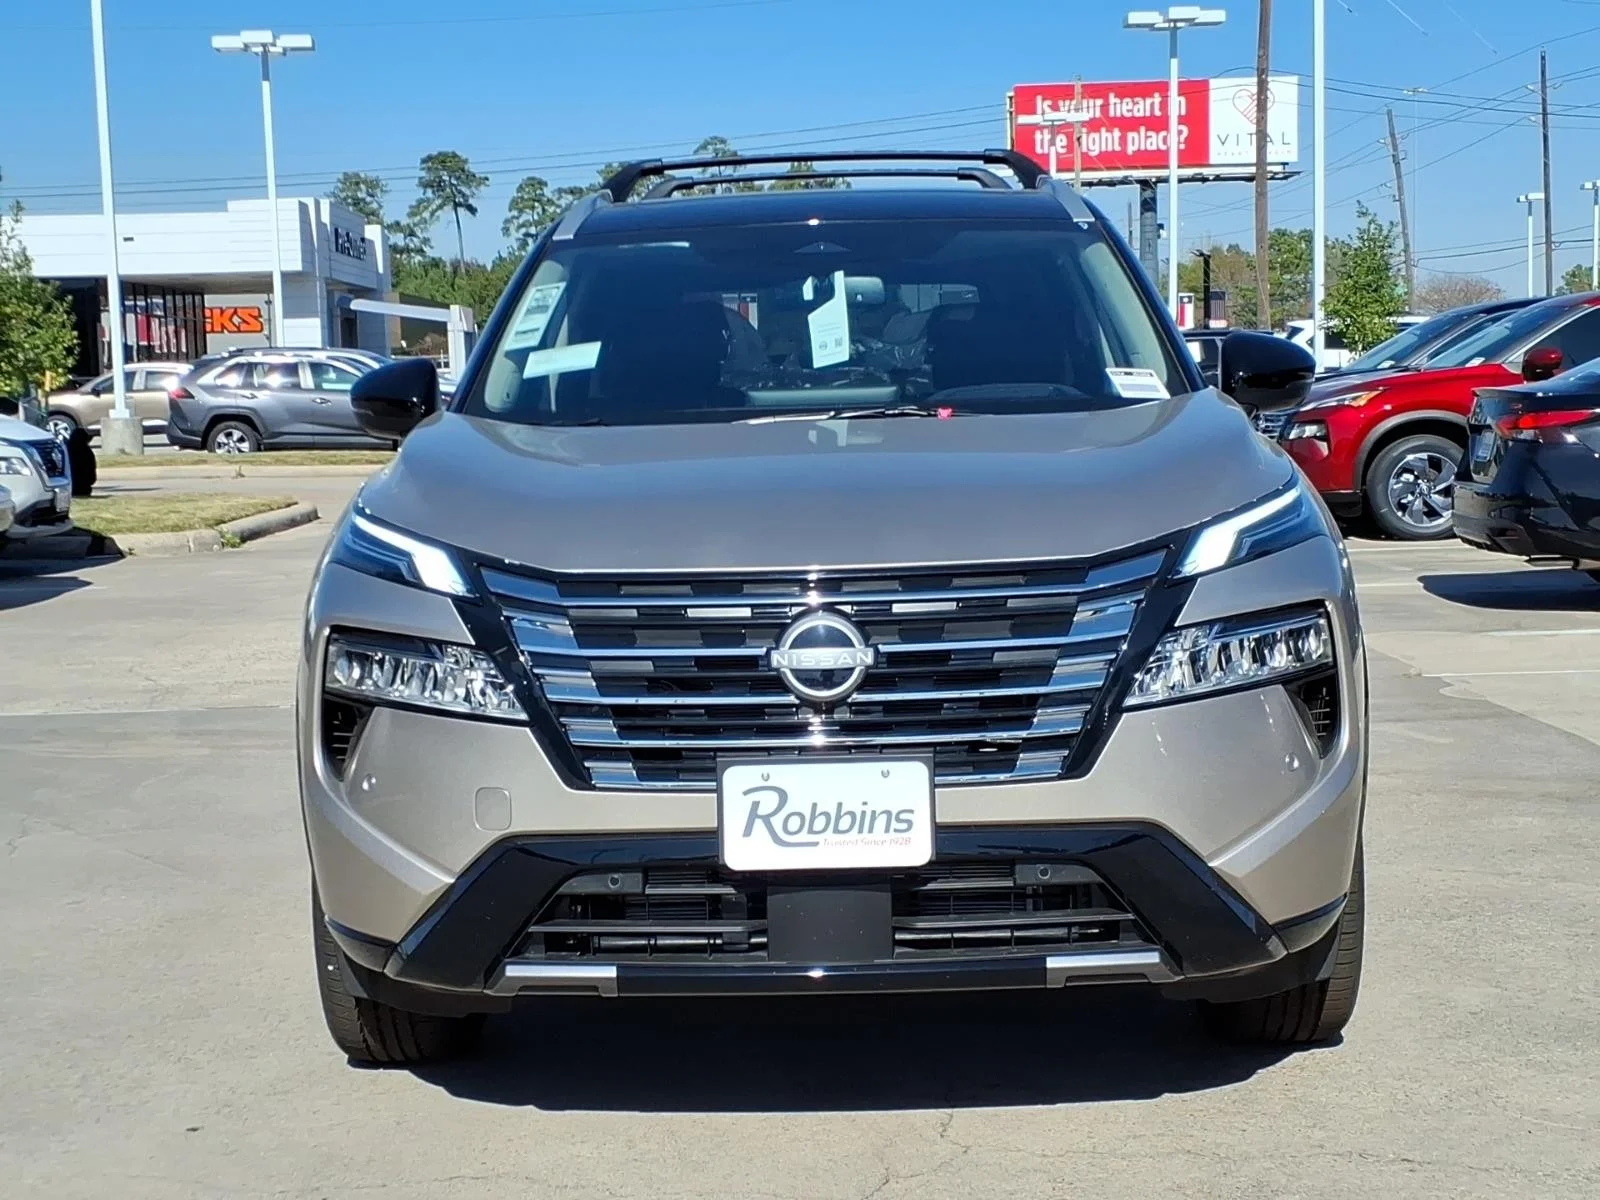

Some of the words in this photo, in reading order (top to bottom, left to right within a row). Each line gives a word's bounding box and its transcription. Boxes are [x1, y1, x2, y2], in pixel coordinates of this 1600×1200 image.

[1108, 92, 1162, 118] heart
[1167, 95, 1187, 117] n
[1077, 126, 1122, 157] ight
[1126, 124, 1190, 156] plac?
[1216, 131, 1291, 147] VITAL
[773, 651, 873, 667] NISSAN
[741, 785, 915, 847] Robbins
